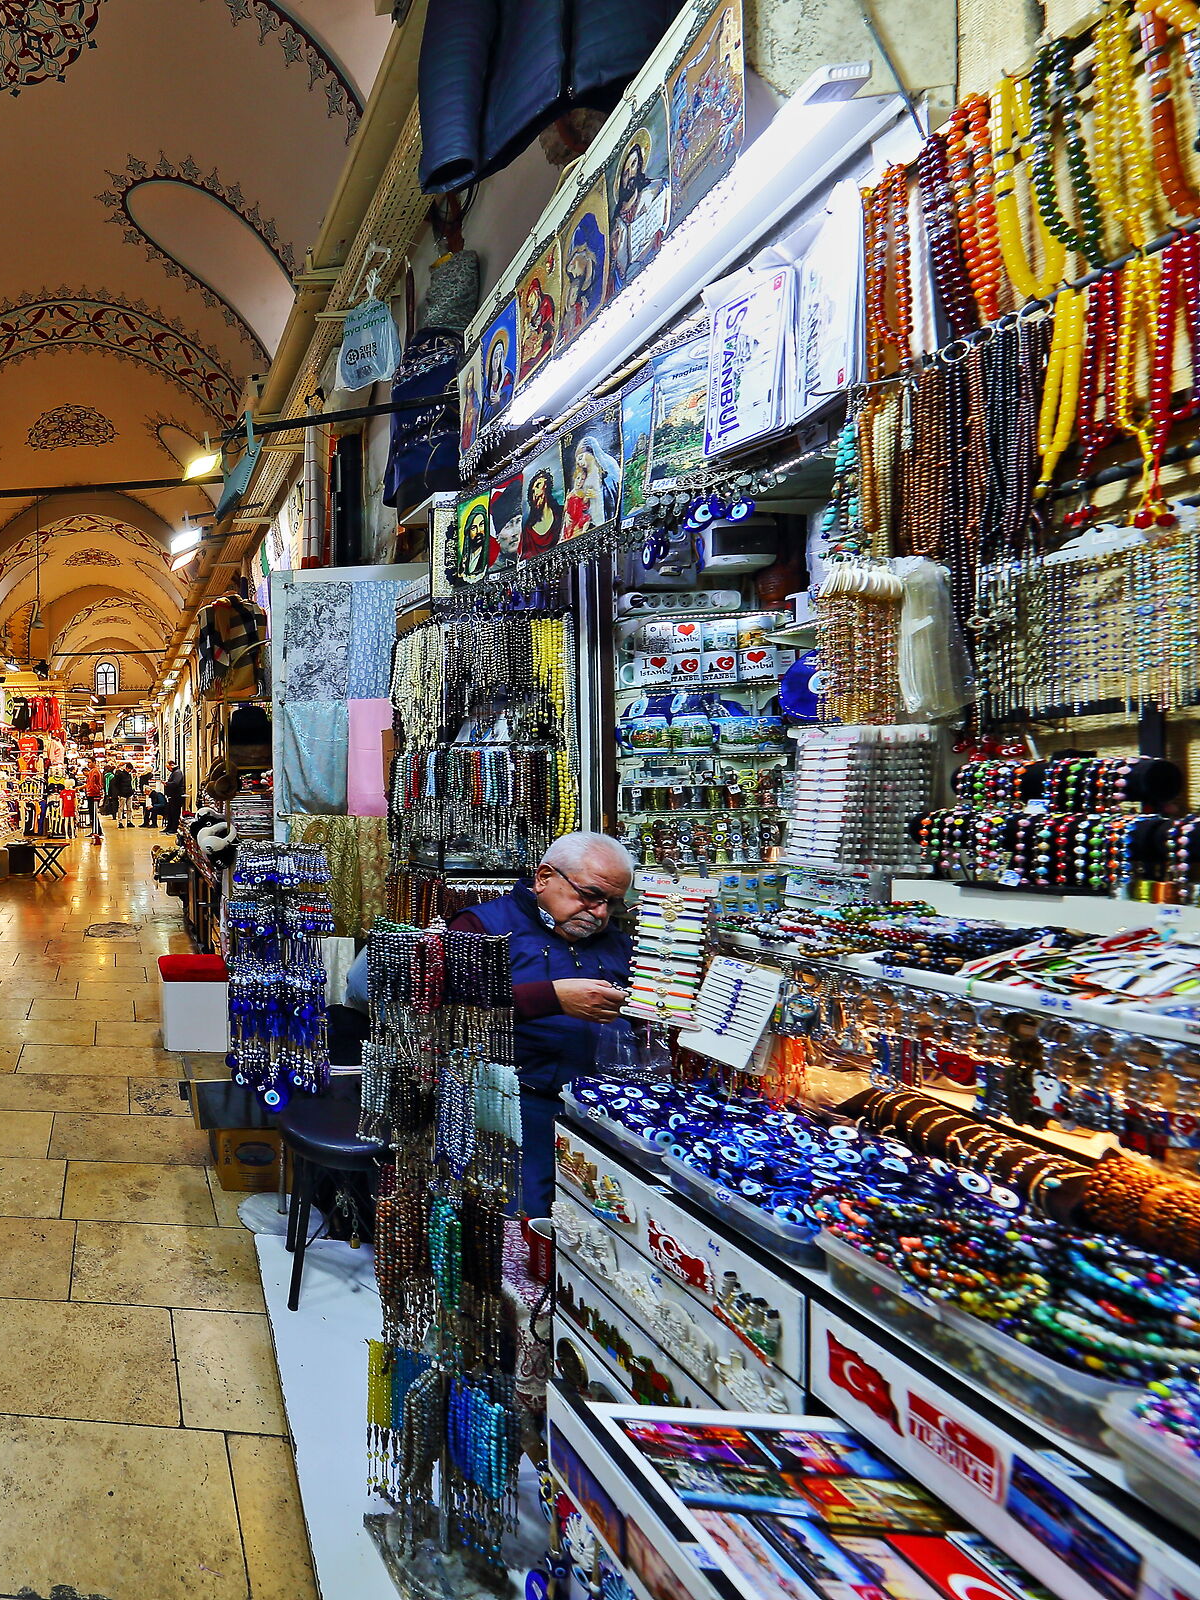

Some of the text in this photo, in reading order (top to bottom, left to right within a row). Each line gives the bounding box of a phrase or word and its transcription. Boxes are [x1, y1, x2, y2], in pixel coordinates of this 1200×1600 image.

[359, 342, 377, 352] SIFIR
[360, 349, 378, 360] ATIK
[710, 352, 719, 408] BLUE MOSQUE
[642, 658, 650, 669] I
